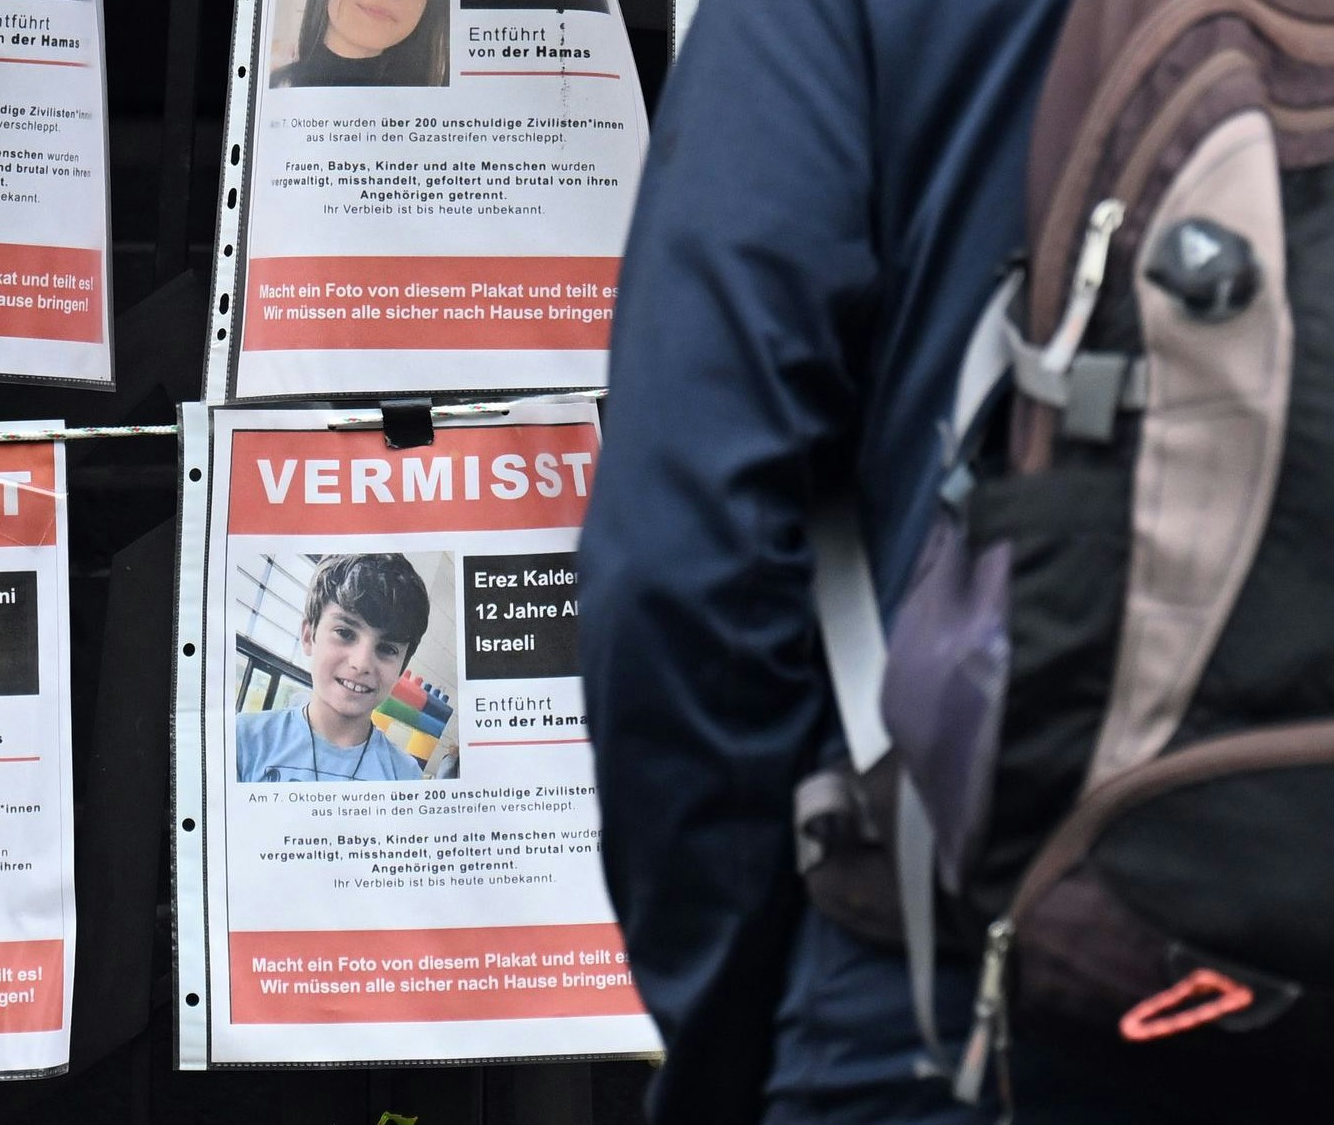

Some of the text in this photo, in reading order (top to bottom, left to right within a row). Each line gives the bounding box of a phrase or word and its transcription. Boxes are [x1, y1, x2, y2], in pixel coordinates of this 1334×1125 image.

[257, 454, 592, 504] VERMISST
[473, 567, 577, 588] Erez Kalde
[474, 599, 579, 620] 12 Jahre Al
[474, 633, 535, 652] Israeli
